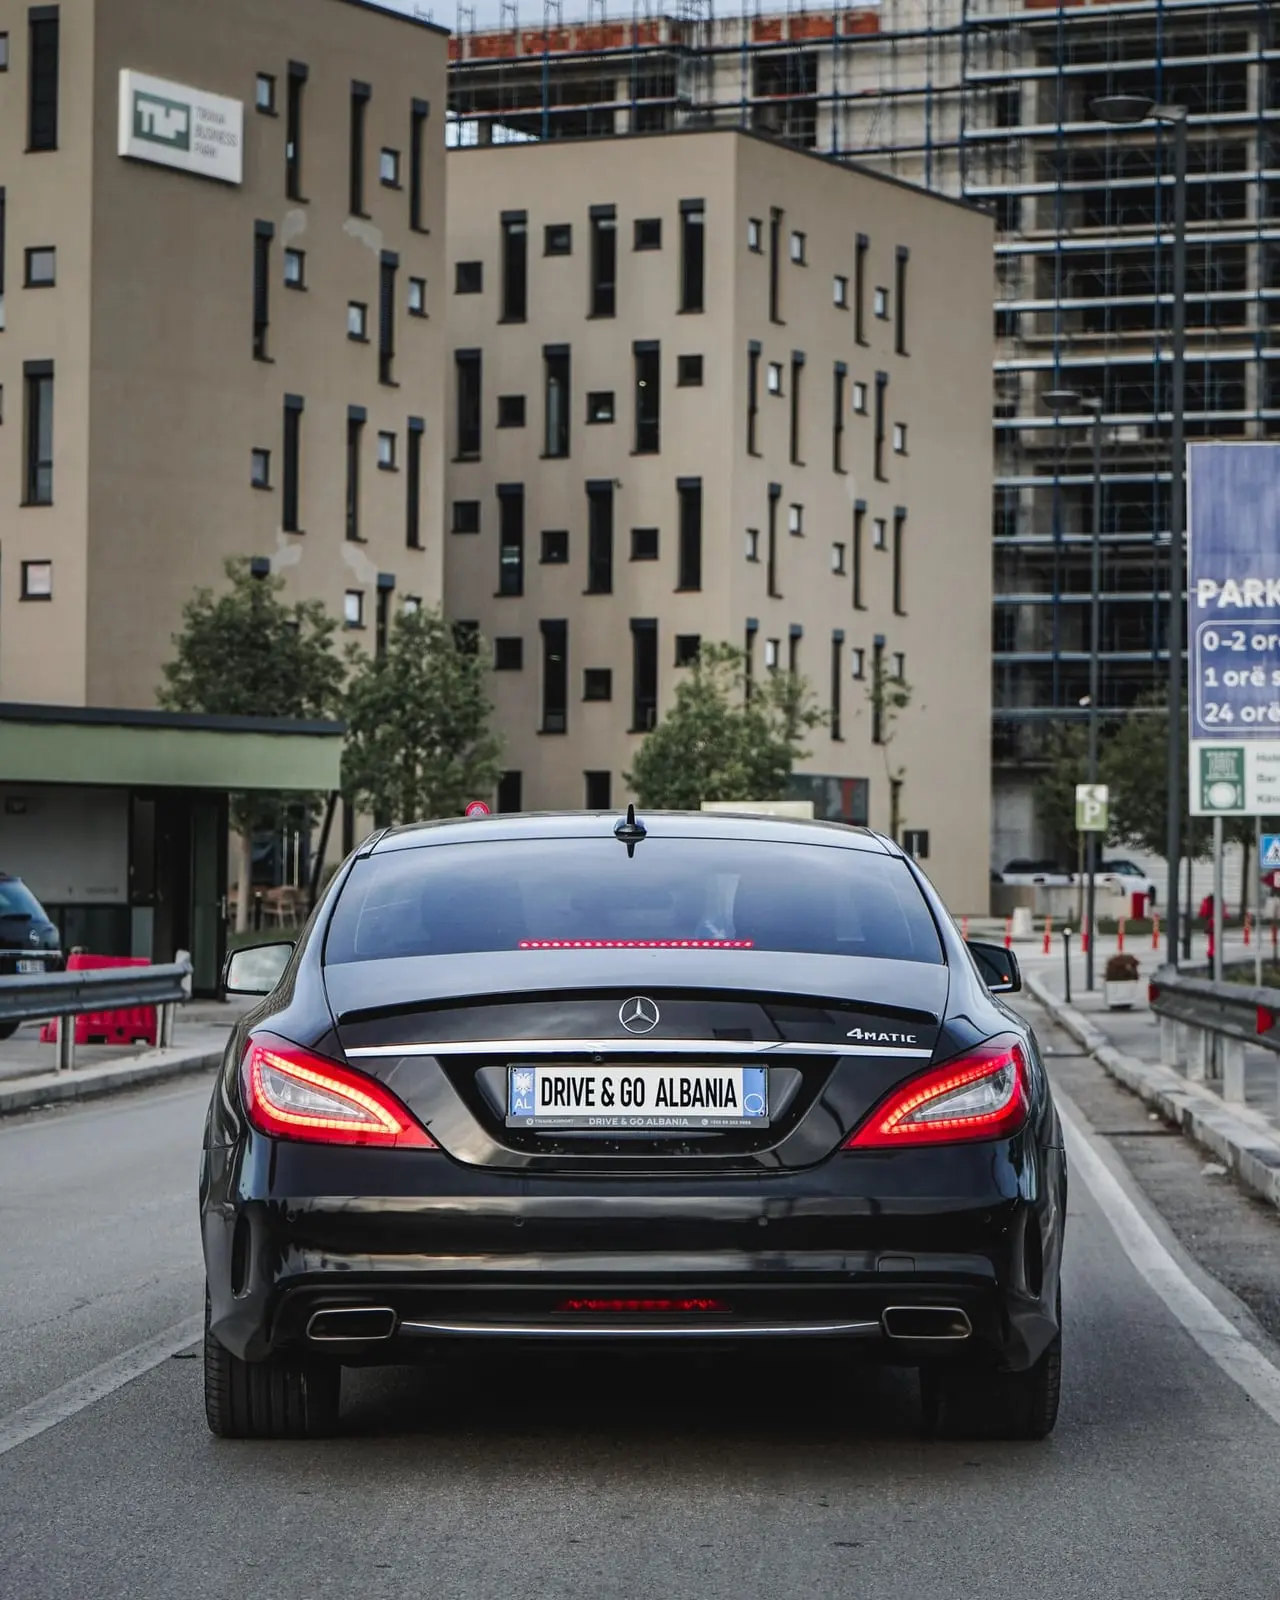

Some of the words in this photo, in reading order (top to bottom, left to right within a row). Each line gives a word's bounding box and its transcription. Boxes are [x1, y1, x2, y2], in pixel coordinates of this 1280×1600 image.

[1251, 633, 1280, 651] or
[1204, 667, 1218, 687] 1
[1223, 665, 1266, 687] orë
[1204, 702, 1234, 722] 24
[1085, 801, 1100, 824] P
[846, 1028, 917, 1043] 4MATIC
[541, 1077, 595, 1106] DRIVE
[601, 1077, 615, 1107] &
[620, 1077, 645, 1107] GO
[655, 1077, 738, 1108] ALBANIA
[515, 1098, 532, 1109] AL
[588, 1117, 618, 1126] DRIVE
[621, 1117, 628, 1126] &
[629, 1117, 644, 1126] GO
[646, 1117, 689, 1126] ALBANIA
